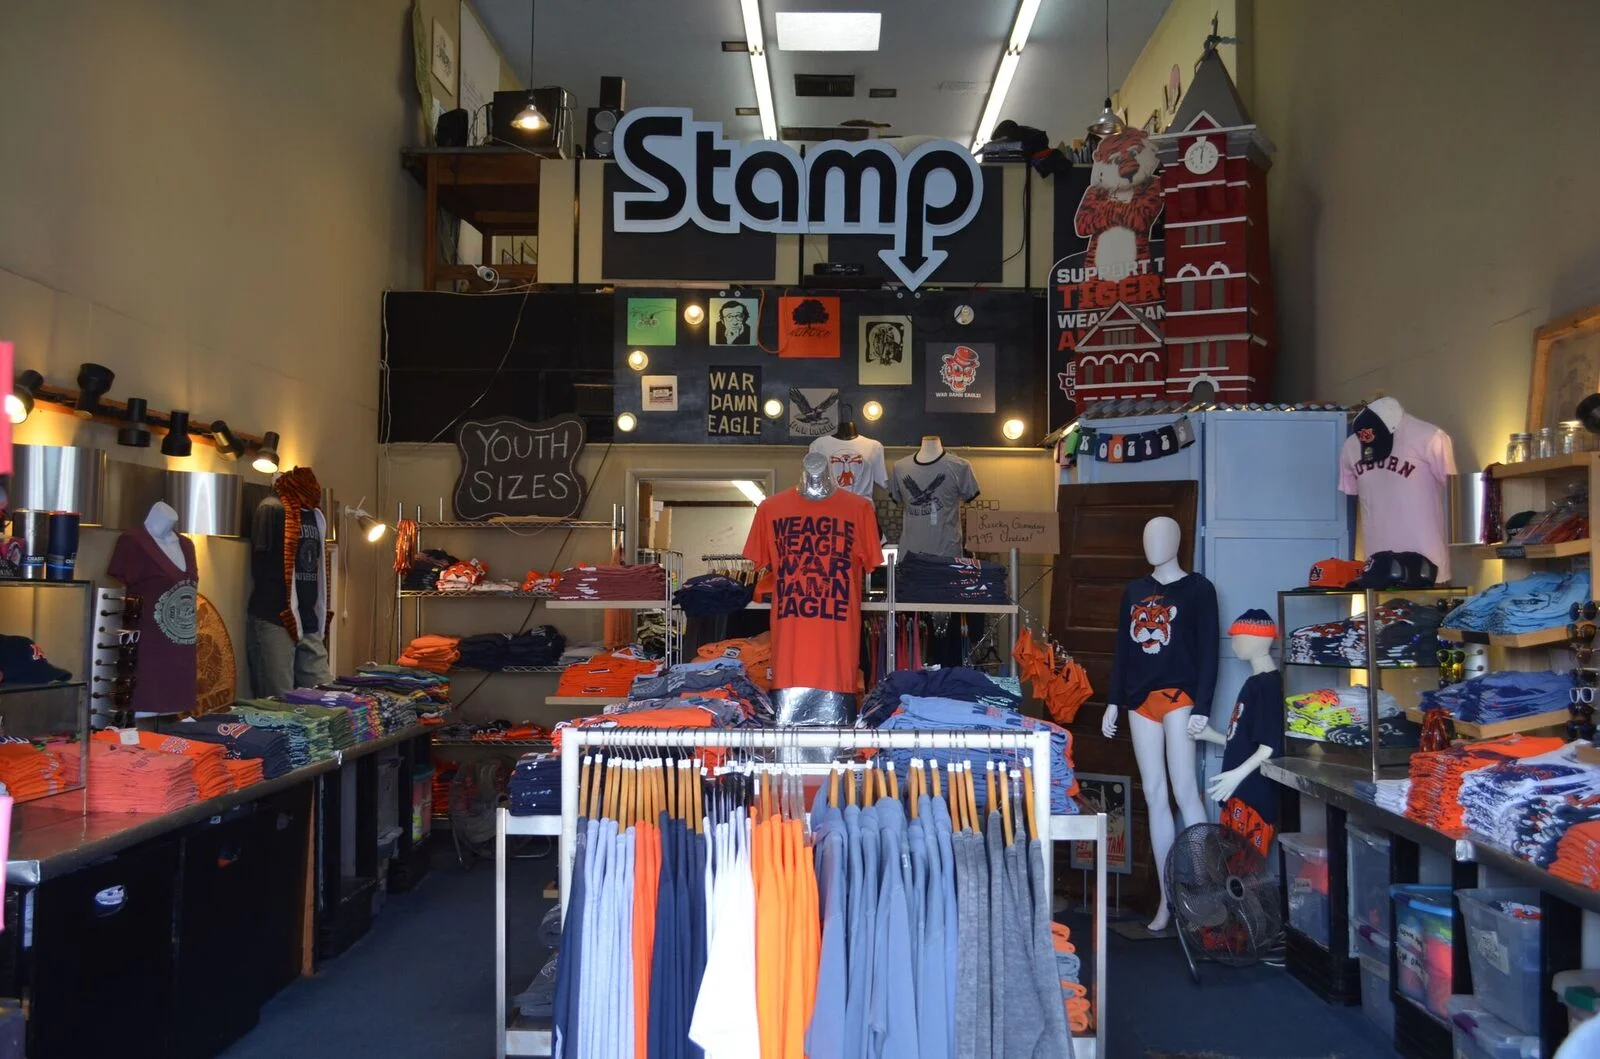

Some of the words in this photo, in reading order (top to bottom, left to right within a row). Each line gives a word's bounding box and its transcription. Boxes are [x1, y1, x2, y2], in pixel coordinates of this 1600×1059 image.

[621, 114, 976, 276] Stamp
[709, 371, 755, 394] WAR
[711, 393, 758, 413] DAMN
[708, 414, 762, 436] EAGLE
[475, 428, 569, 467] YOUTH
[469, 470, 571, 503] SIZES
[772, 515, 855, 539] WEAGLE
[774, 534, 854, 560] WEAGLE
[776, 554, 852, 580] WAR
[776, 576, 850, 601] DAMN
[777, 596, 850, 622] EAGLE
